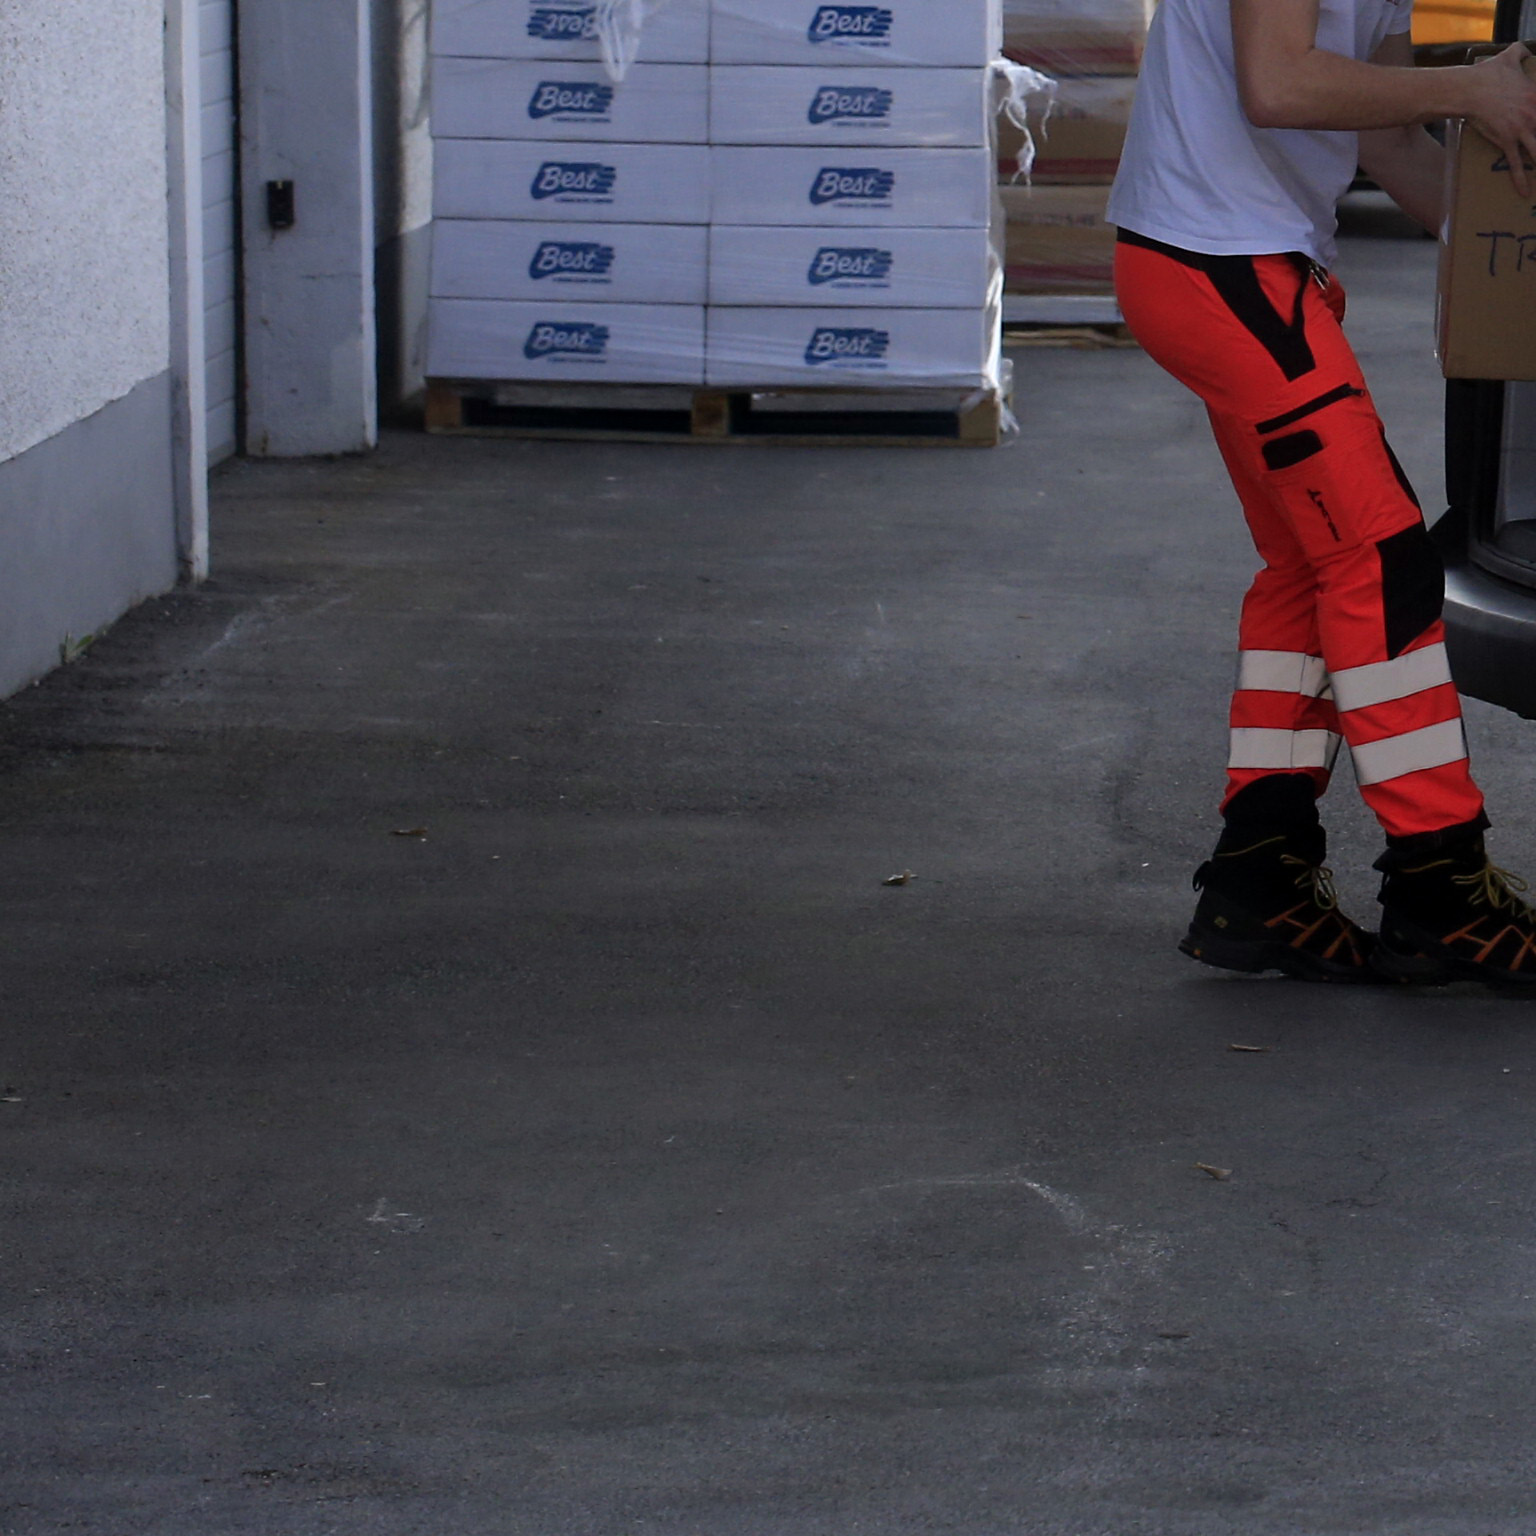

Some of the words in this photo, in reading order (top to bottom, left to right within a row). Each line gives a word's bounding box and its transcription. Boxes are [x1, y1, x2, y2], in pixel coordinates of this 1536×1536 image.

[815, 9, 876, 35] Best
[535, 84, 597, 110] Best
[816, 89, 877, 115] Best
[538, 165, 600, 191] Best
[817, 171, 878, 197] Best
[536, 245, 598, 271] Best
[815, 251, 876, 277] Best
[531, 325, 593, 351] Best
[812, 331, 873, 357] Best
